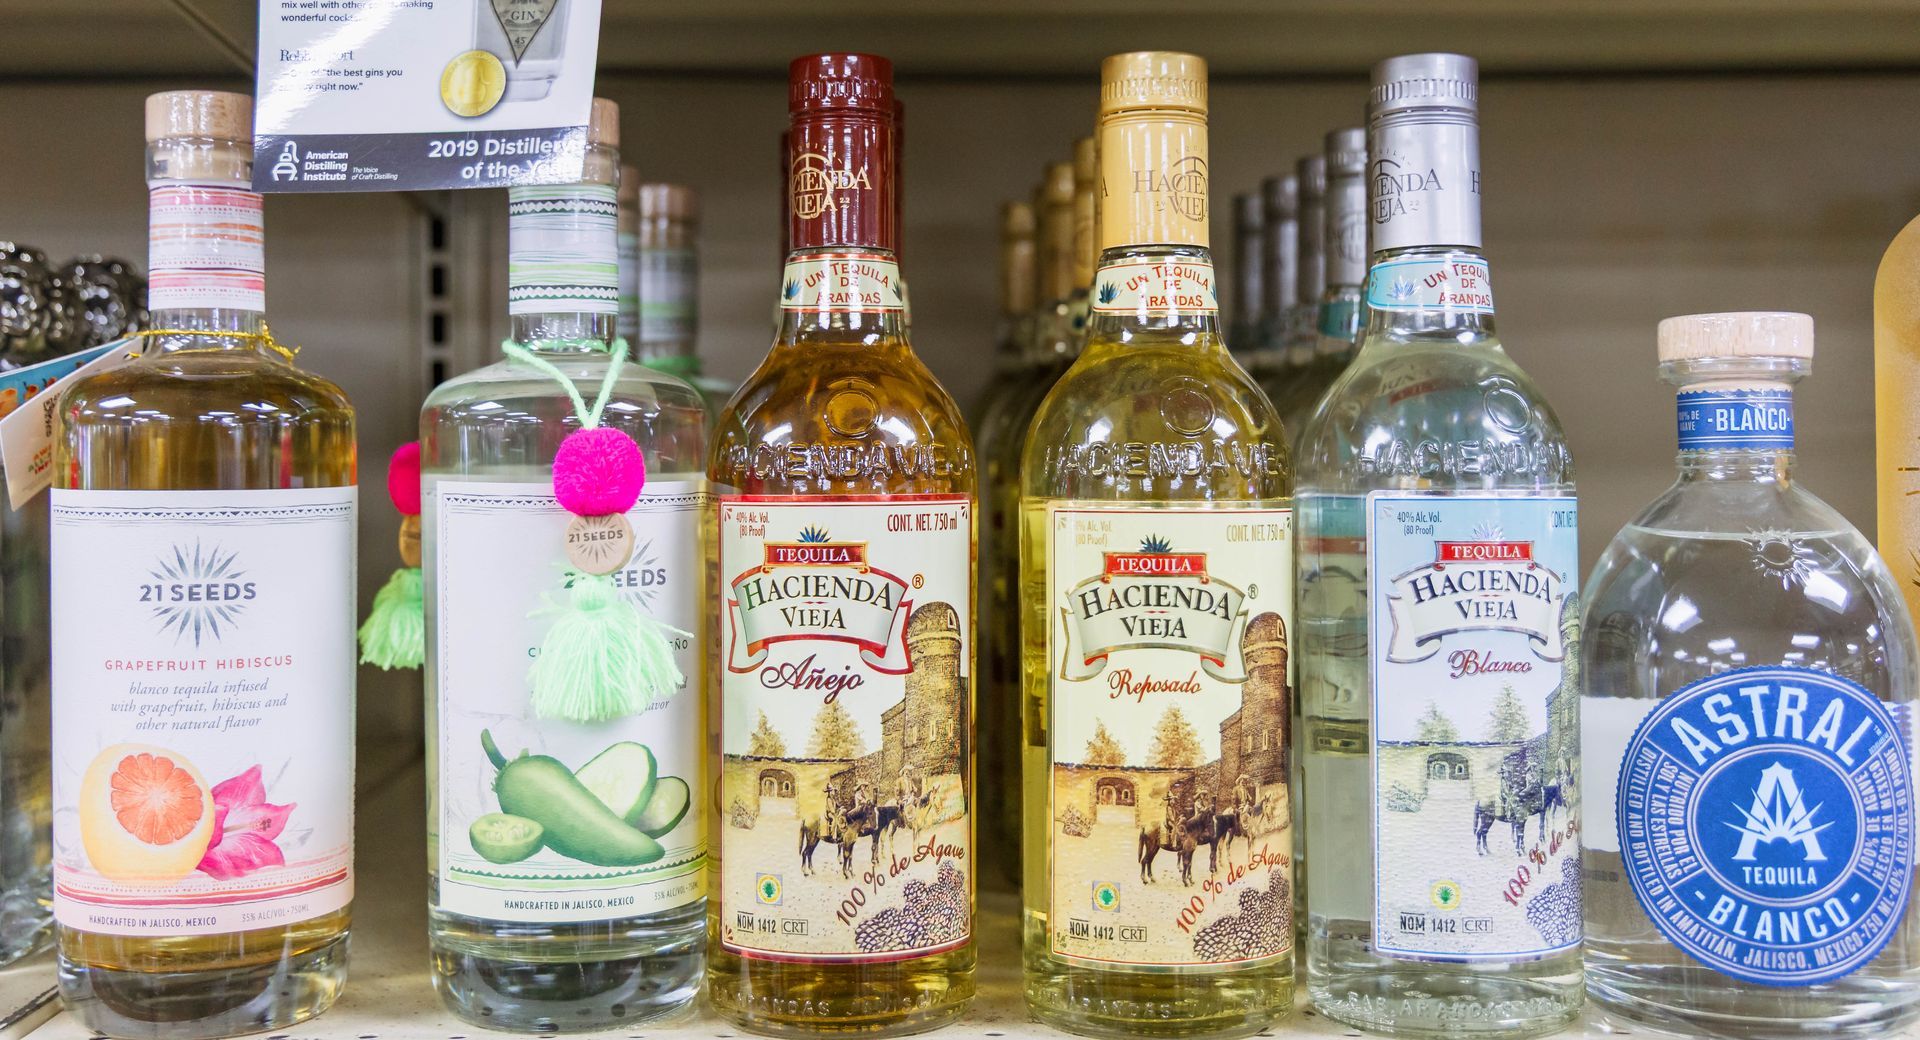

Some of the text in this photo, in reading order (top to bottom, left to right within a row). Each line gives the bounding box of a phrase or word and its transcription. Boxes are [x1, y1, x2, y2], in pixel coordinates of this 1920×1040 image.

[281, 0, 297, 9] mix
[300, 0, 318, 9] well
[320, 0, 340, 9] with
[281, 13, 326, 22] wonderful
[510, 10, 536, 21] GIN
[515, 36, 527, 45] 45
[344, 68, 362, 77] best
[365, 68, 383, 78] gins
[386, 70, 403, 78] you
[305, 151, 349, 160] American
[428, 136, 570, 158] 2019 Distillery
[304, 161, 348, 171] Distilling
[462, 161, 484, 179] of
[487, 160, 520, 179] the
[303, 172, 347, 181] Institute
[804, 262, 889, 289] UN TEQUILA
[1126, 265, 1209, 292] UN TEQUILA
[1423, 270, 1447, 289] UN
[1461, 278, 1477, 289] DE
[1438, 292, 1491, 306] ARANDAS
[1715, 407, 1787, 432] BLANCO
[748, 512, 758, 523] Alc.
[759, 512, 770, 523] Vol.
[887, 511, 958, 532] CONT. NET. 750 ml
[1397, 511, 1442, 523] 40% Alc. Vol.
[569, 529, 623, 543] 21 SEEDS
[748, 524, 766, 539] Proof)
[1227, 525, 1249, 542] CONT.
[1403, 525, 1434, 536] (80 Proof)
[776, 548, 850, 563] TEQUILA
[1451, 545, 1521, 559] TEQUILA
[1117, 557, 1192, 573] TEQUILA
[139, 582, 257, 602] 21 SEEDS
[742, 575, 893, 612] HACIENDA
[1408, 570, 1552, 605] HACIENDA
[1078, 584, 1231, 621] HACIENDA
[1454, 598, 1518, 620] VIEJA
[780, 606, 847, 630] VIEJA
[1120, 615, 1188, 639] VIEJA
[105, 655, 293, 672] GRAPEFRUIT HIBISCUS
[1448, 649, 1533, 680] Blanco
[129, 678, 270, 699] blanco tequila infused
[760, 653, 865, 704] Añejo
[1107, 669, 1202, 704] Reposado
[110, 693, 289, 717] with grapefruit, hibiscus and
[135, 714, 262, 732] other natural flavor
[1670, 685, 1872, 766] ASTRAL
[1628, 746, 1657, 809] DISTILLED
[1869, 759, 1892, 810] MEXICO
[1855, 770, 1880, 811] AGAVE
[1628, 812, 1643, 838] AND
[1650, 761, 1683, 880] SOL Y LAS ESTRELLAS
[1668, 771, 1698, 874] NUTRIDO POR EL
[1866, 815, 1880, 832] DE
[1882, 814, 1893, 831] EN
[1858, 838, 1880, 873] 100%
[1872, 836, 1892, 882] HECHO
[1503, 864, 1531, 907] 100
[1528, 842, 1547, 874] %
[1632, 841, 1665, 897] BOTTLED
[1743, 866, 1817, 885] TEQUILA
[836, 834, 965, 927] 100 % de Agave
[1176, 843, 1290, 934] 100 % de Agave
[504, 896, 635, 911] HANDCRAFTED IN JALISCO, MEXICO
[1657, 894, 1676, 914] IN
[89, 915, 217, 928] HANDCRAFTED IN JALISCO, MEXICO
[241, 911, 256, 922] 35%
[737, 914, 776, 934] NOM 1412
[1400, 915, 1456, 933] NOM 1412
[1464, 918, 1491, 932] CRT
[1707, 889, 1851, 943] BLANCO
[783, 920, 807, 934] CRT
[1070, 920, 1114, 941] NOM 1412
[1121, 927, 1146, 941] CRT
[1669, 909, 1737, 962] AMATITÁN,
[1743, 948, 1812, 970] JALISCO,
